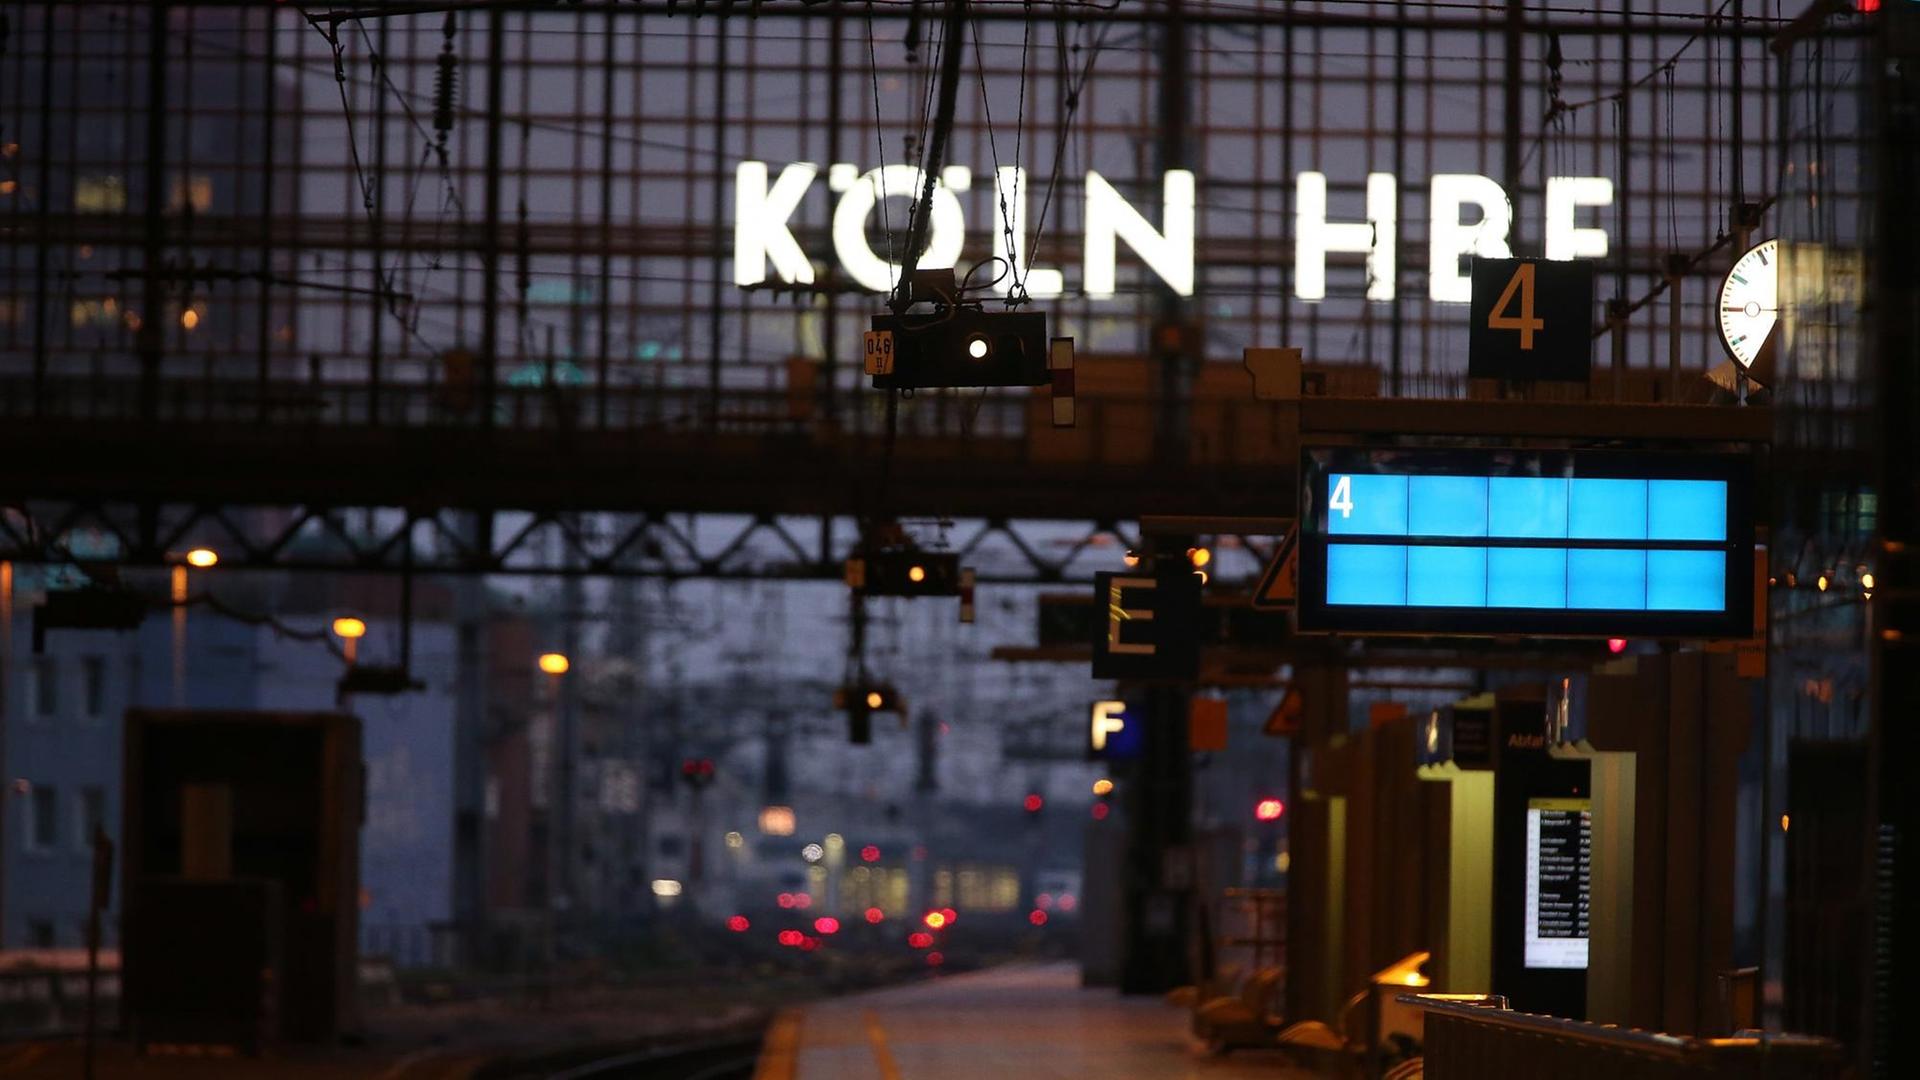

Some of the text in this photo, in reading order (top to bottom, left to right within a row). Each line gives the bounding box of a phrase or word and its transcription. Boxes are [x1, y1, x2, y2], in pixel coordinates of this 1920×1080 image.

[733, 160, 1613, 302] KÖLN HBF
[1488, 263, 1544, 350] 4
[1329, 475, 1353, 518] 4
[1108, 576, 1157, 654] E
[1091, 700, 1127, 751] F
